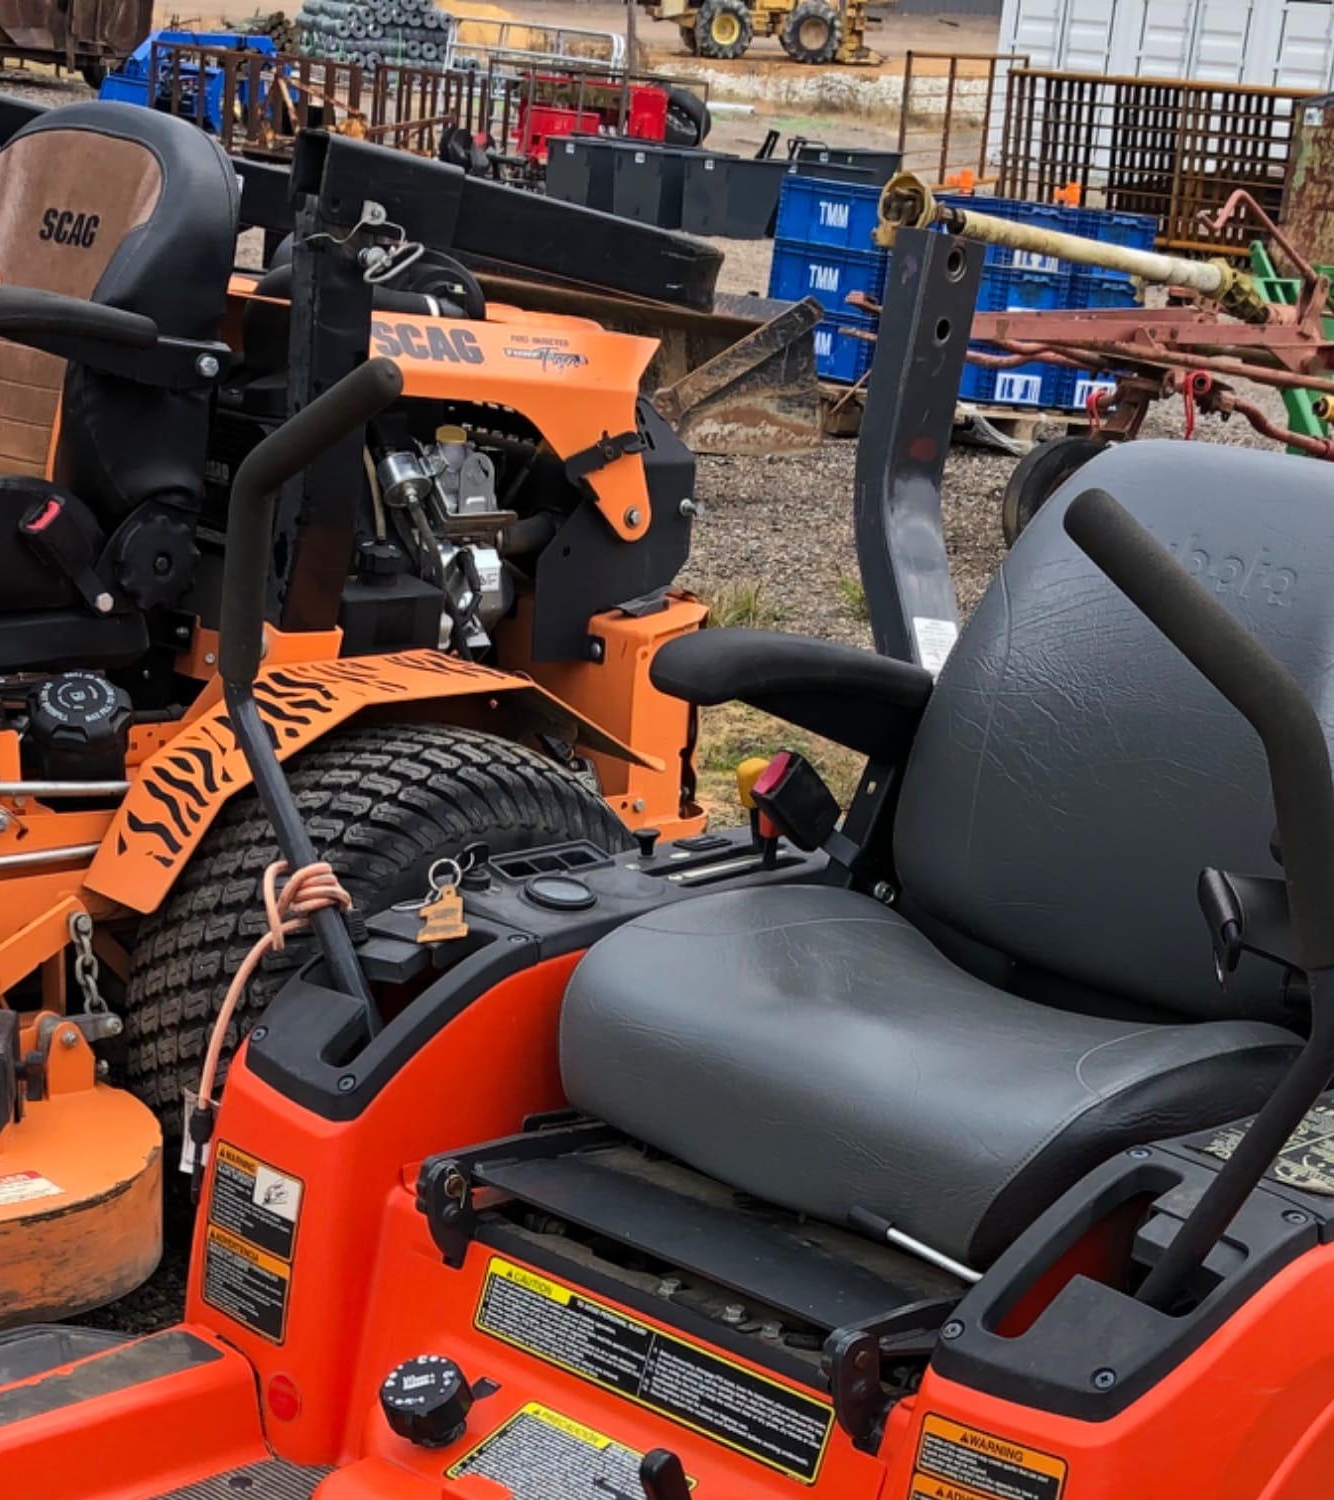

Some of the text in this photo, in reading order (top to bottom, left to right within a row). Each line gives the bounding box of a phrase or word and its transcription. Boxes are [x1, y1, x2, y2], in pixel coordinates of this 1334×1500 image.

[39, 208, 100, 248] SCAG
[819, 201, 849, 229] TMM
[809, 264, 839, 292] TMM
[371, 320, 485, 364] SCAG
[814, 331, 832, 356] MM
[514, 1274, 553, 1295] CAUTION
[968, 1434, 1024, 1463] WARNING
